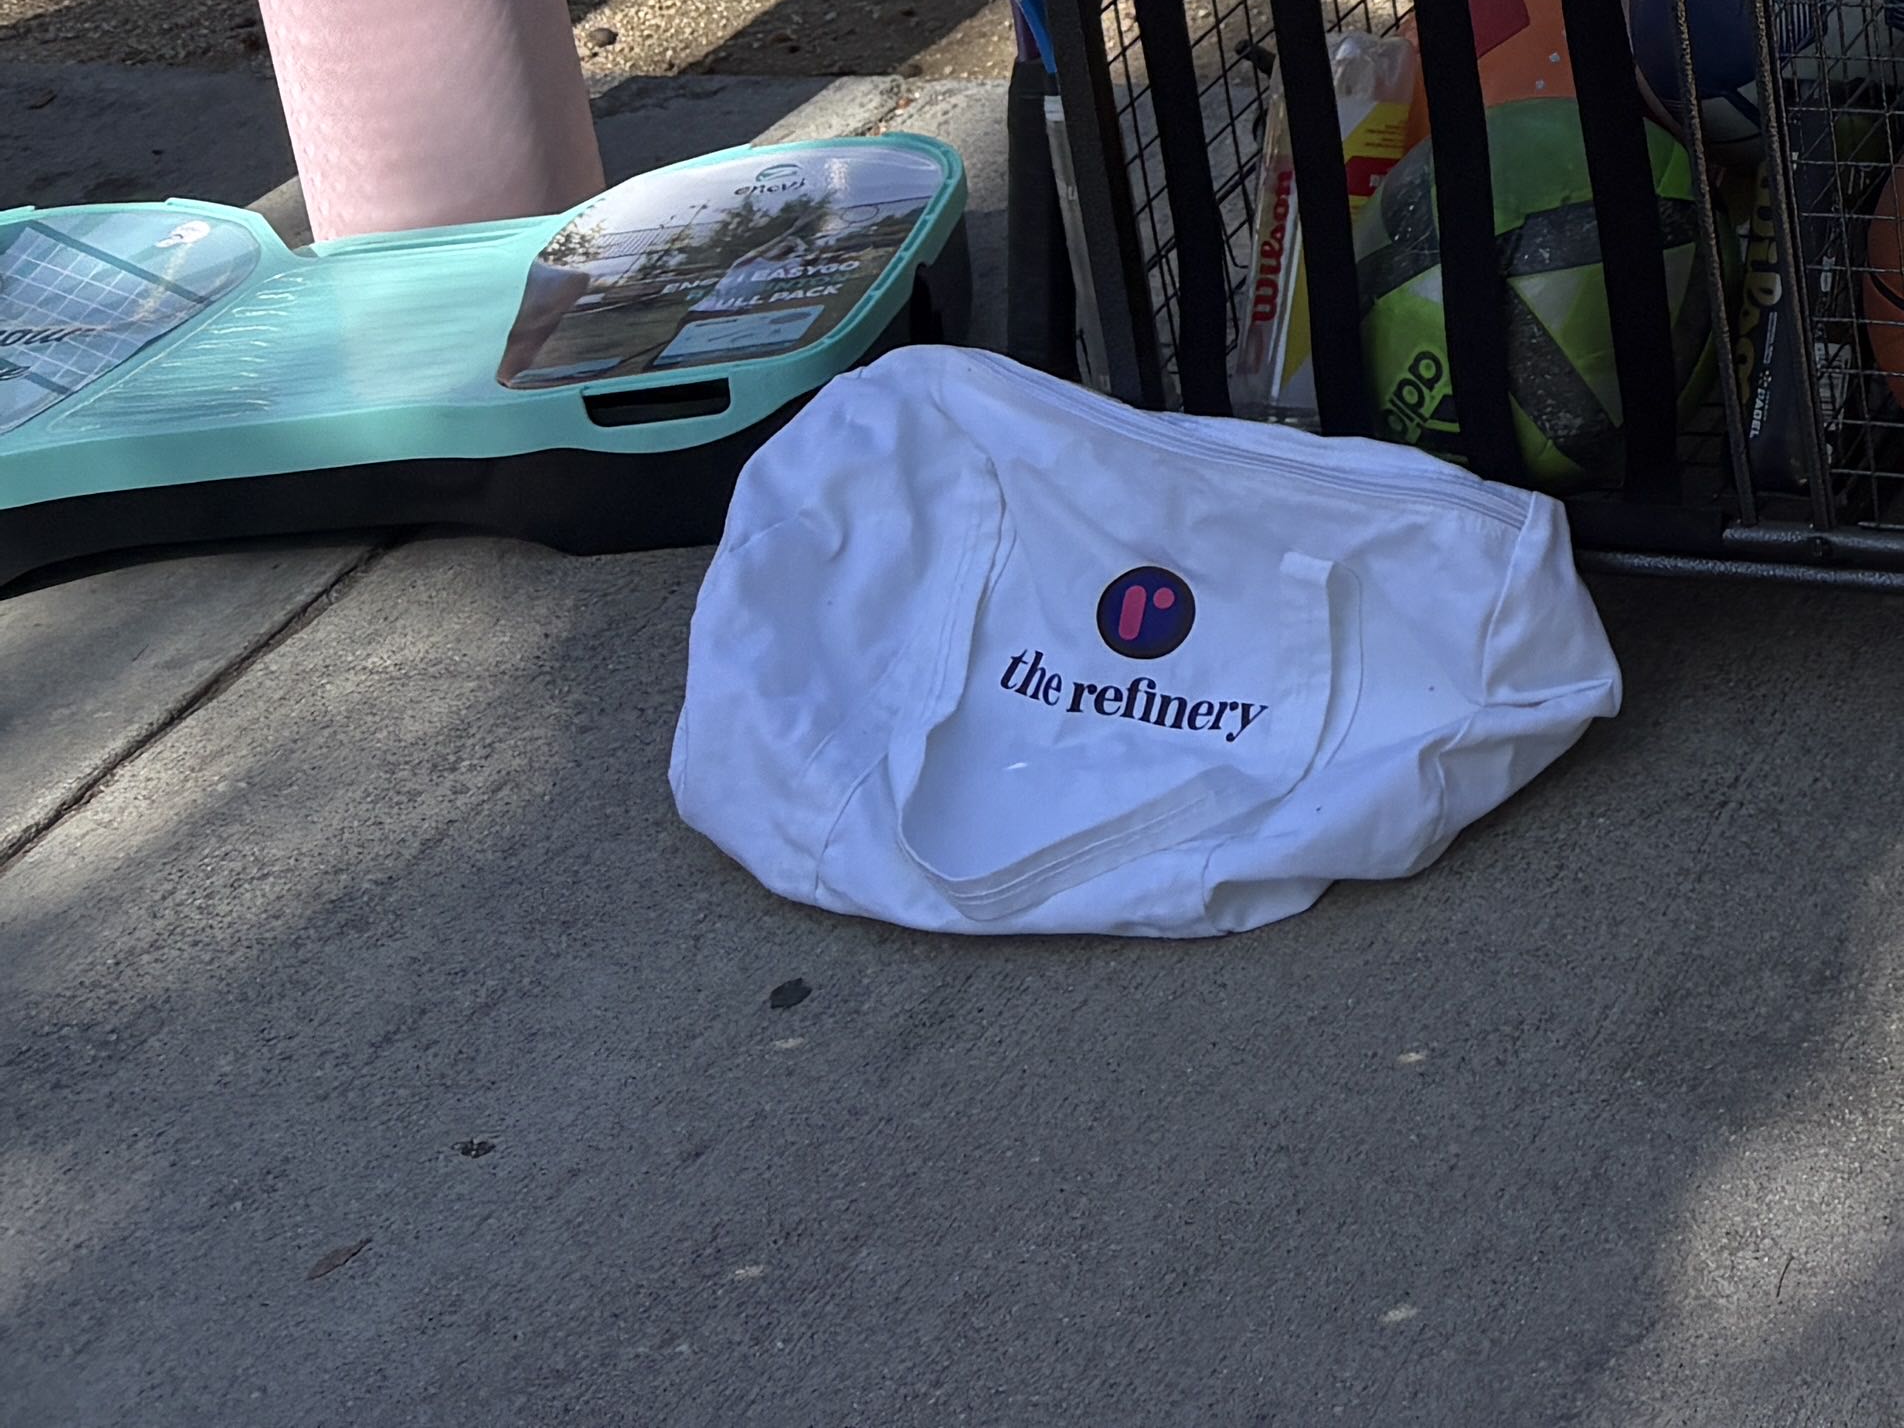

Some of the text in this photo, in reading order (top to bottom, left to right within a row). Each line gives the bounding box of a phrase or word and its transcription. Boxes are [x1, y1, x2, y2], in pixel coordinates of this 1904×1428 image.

[1253, 170, 1293, 324] Wilson
[768, 283, 843, 304] PACK
[1749, 388, 1768, 439] PADEL
[999, 647, 1269, 743] the refinery
